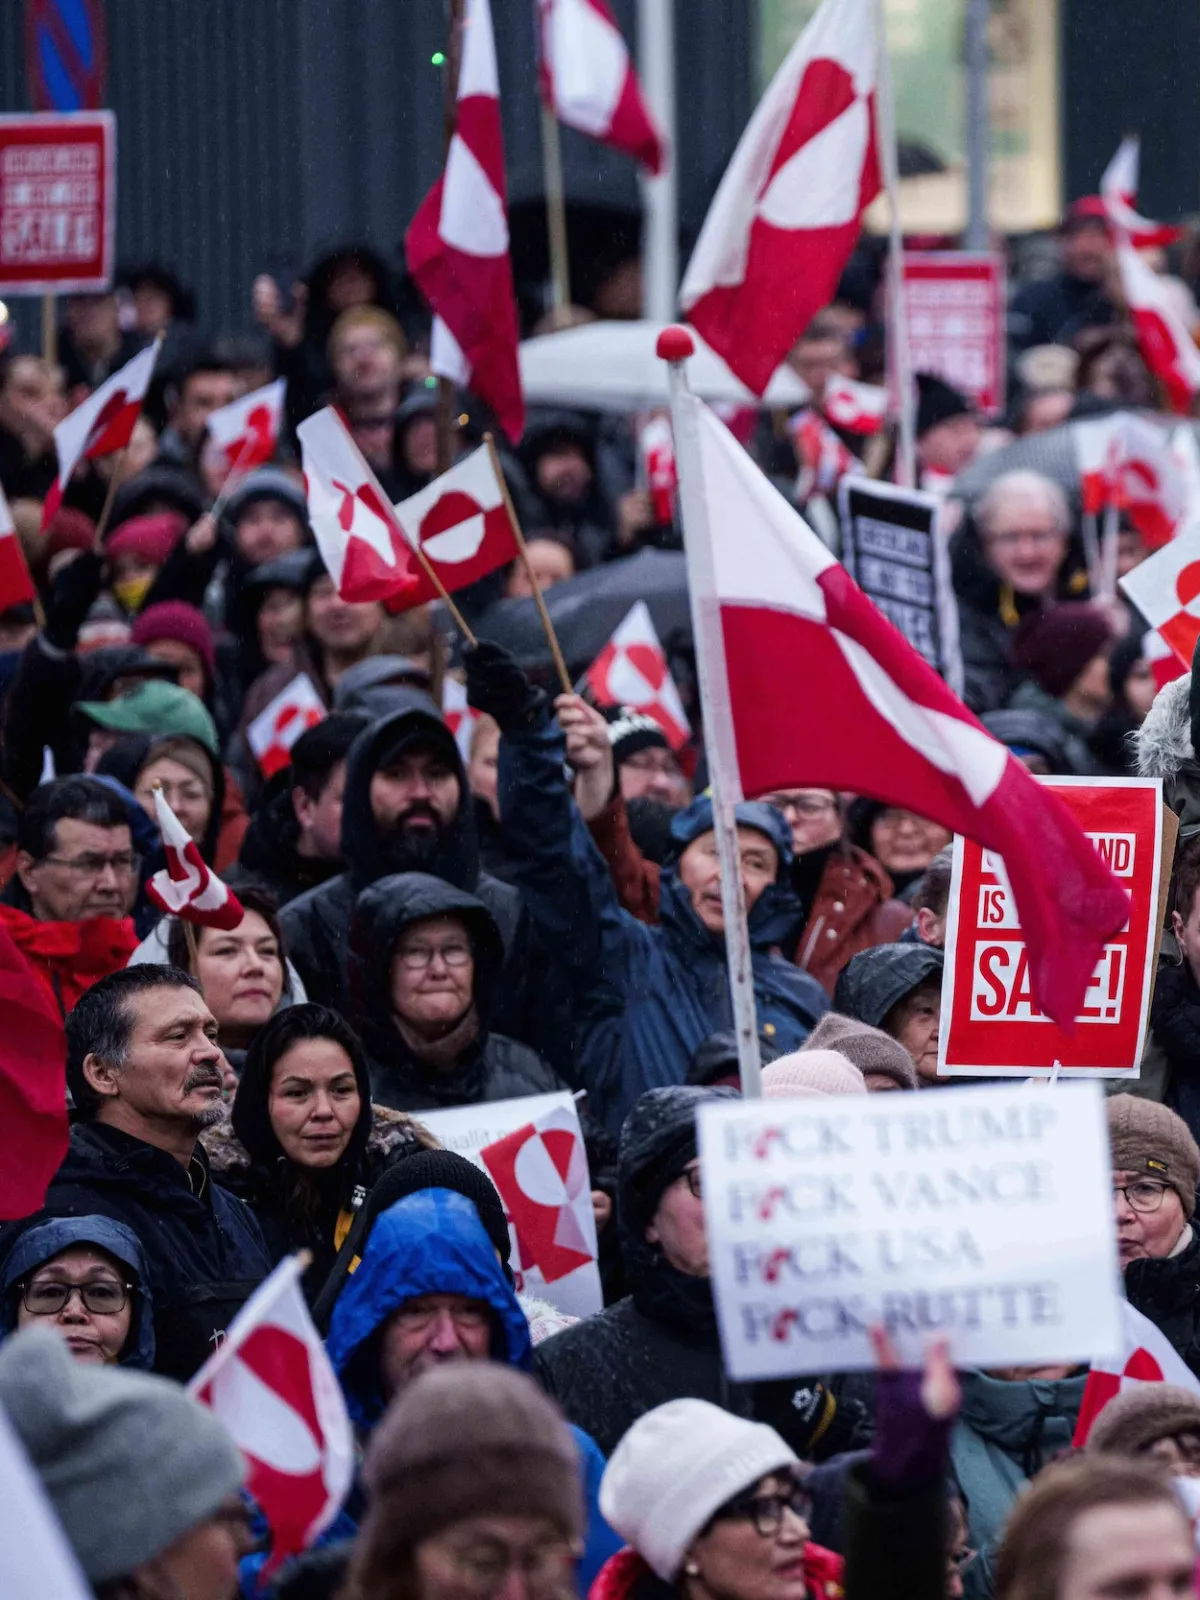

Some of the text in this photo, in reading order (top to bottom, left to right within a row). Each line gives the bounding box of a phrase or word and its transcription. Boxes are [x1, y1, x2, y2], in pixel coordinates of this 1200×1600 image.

[982, 890, 1006, 923] IS
[976, 945, 1122, 1018] SAE!
[865, 1104, 1057, 1156] TRUMP
[870, 1160, 1055, 1210] VANCE
[876, 1228, 984, 1271] USA
[882, 1281, 1063, 1331] RUTTE
